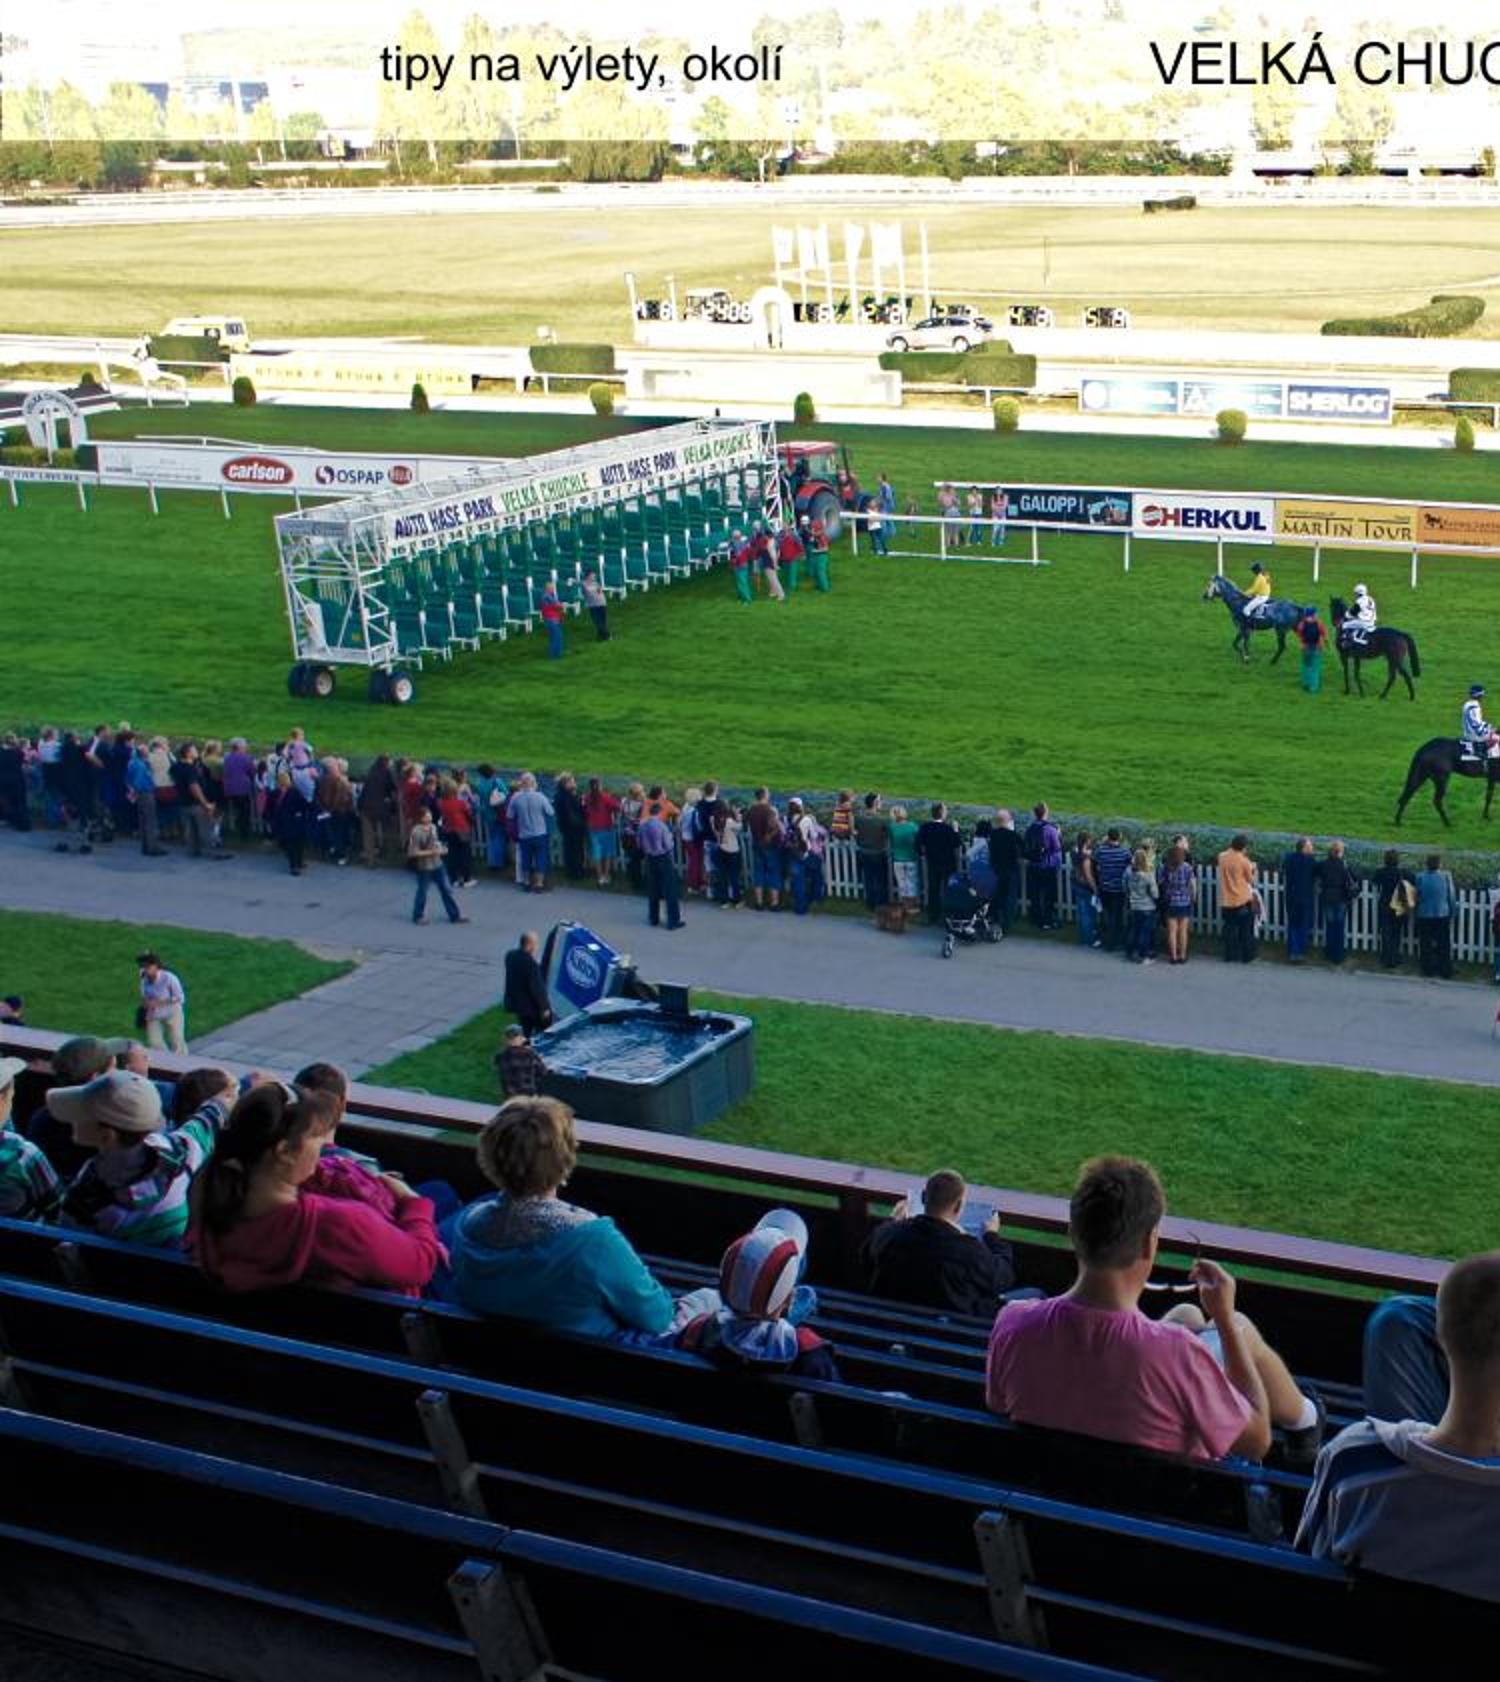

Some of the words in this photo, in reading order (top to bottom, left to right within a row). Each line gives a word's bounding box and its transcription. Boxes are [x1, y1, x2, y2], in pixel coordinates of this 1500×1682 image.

[1289, 391, 1389, 413] SHERLOG
[337, 469, 384, 485] OSPAP
[395, 512, 429, 540] AUTO
[429, 504, 461, 532] HASE
[463, 495, 497, 522] PARK
[600, 462, 628, 486] AUTO
[653, 450, 679, 473] PARK
[1163, 507, 1267, 531] HERKUL
[1281, 517, 1355, 537] MARTIN
